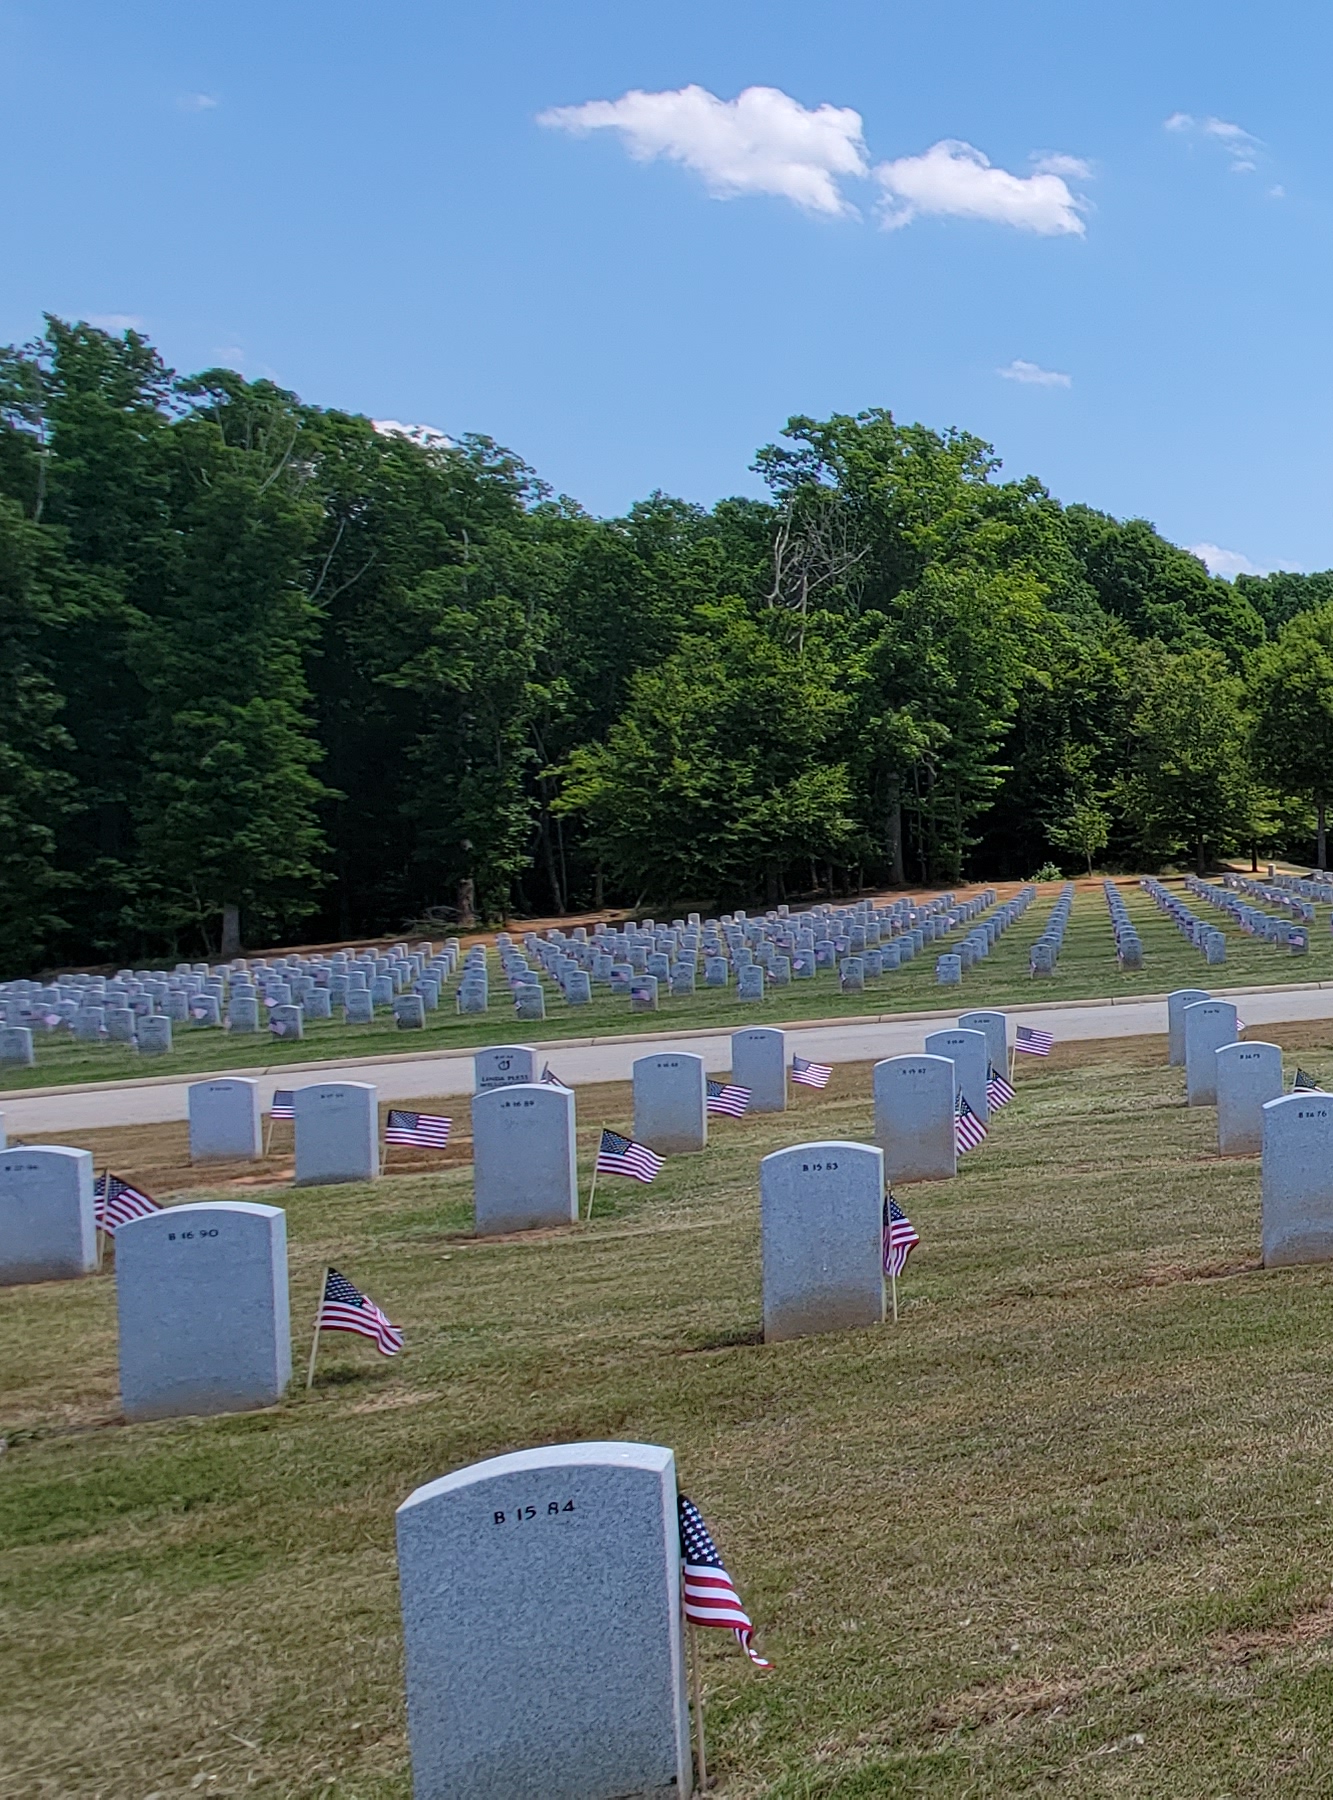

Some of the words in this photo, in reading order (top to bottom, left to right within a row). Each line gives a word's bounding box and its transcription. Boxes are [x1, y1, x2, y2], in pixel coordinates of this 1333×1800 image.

[1317, 1110, 1327, 1118] 76
[803, 1163, 809, 1172] B
[813, 1162, 822, 1171] 15
[826, 1162, 839, 1170] 83
[168, 1233, 176, 1241] B
[181, 1231, 194, 1240] 16
[200, 1229, 219, 1239] 90
[494, 1510, 506, 1525] B
[517, 1505, 537, 1521] 15
[548, 1499, 576, 1516] 84
